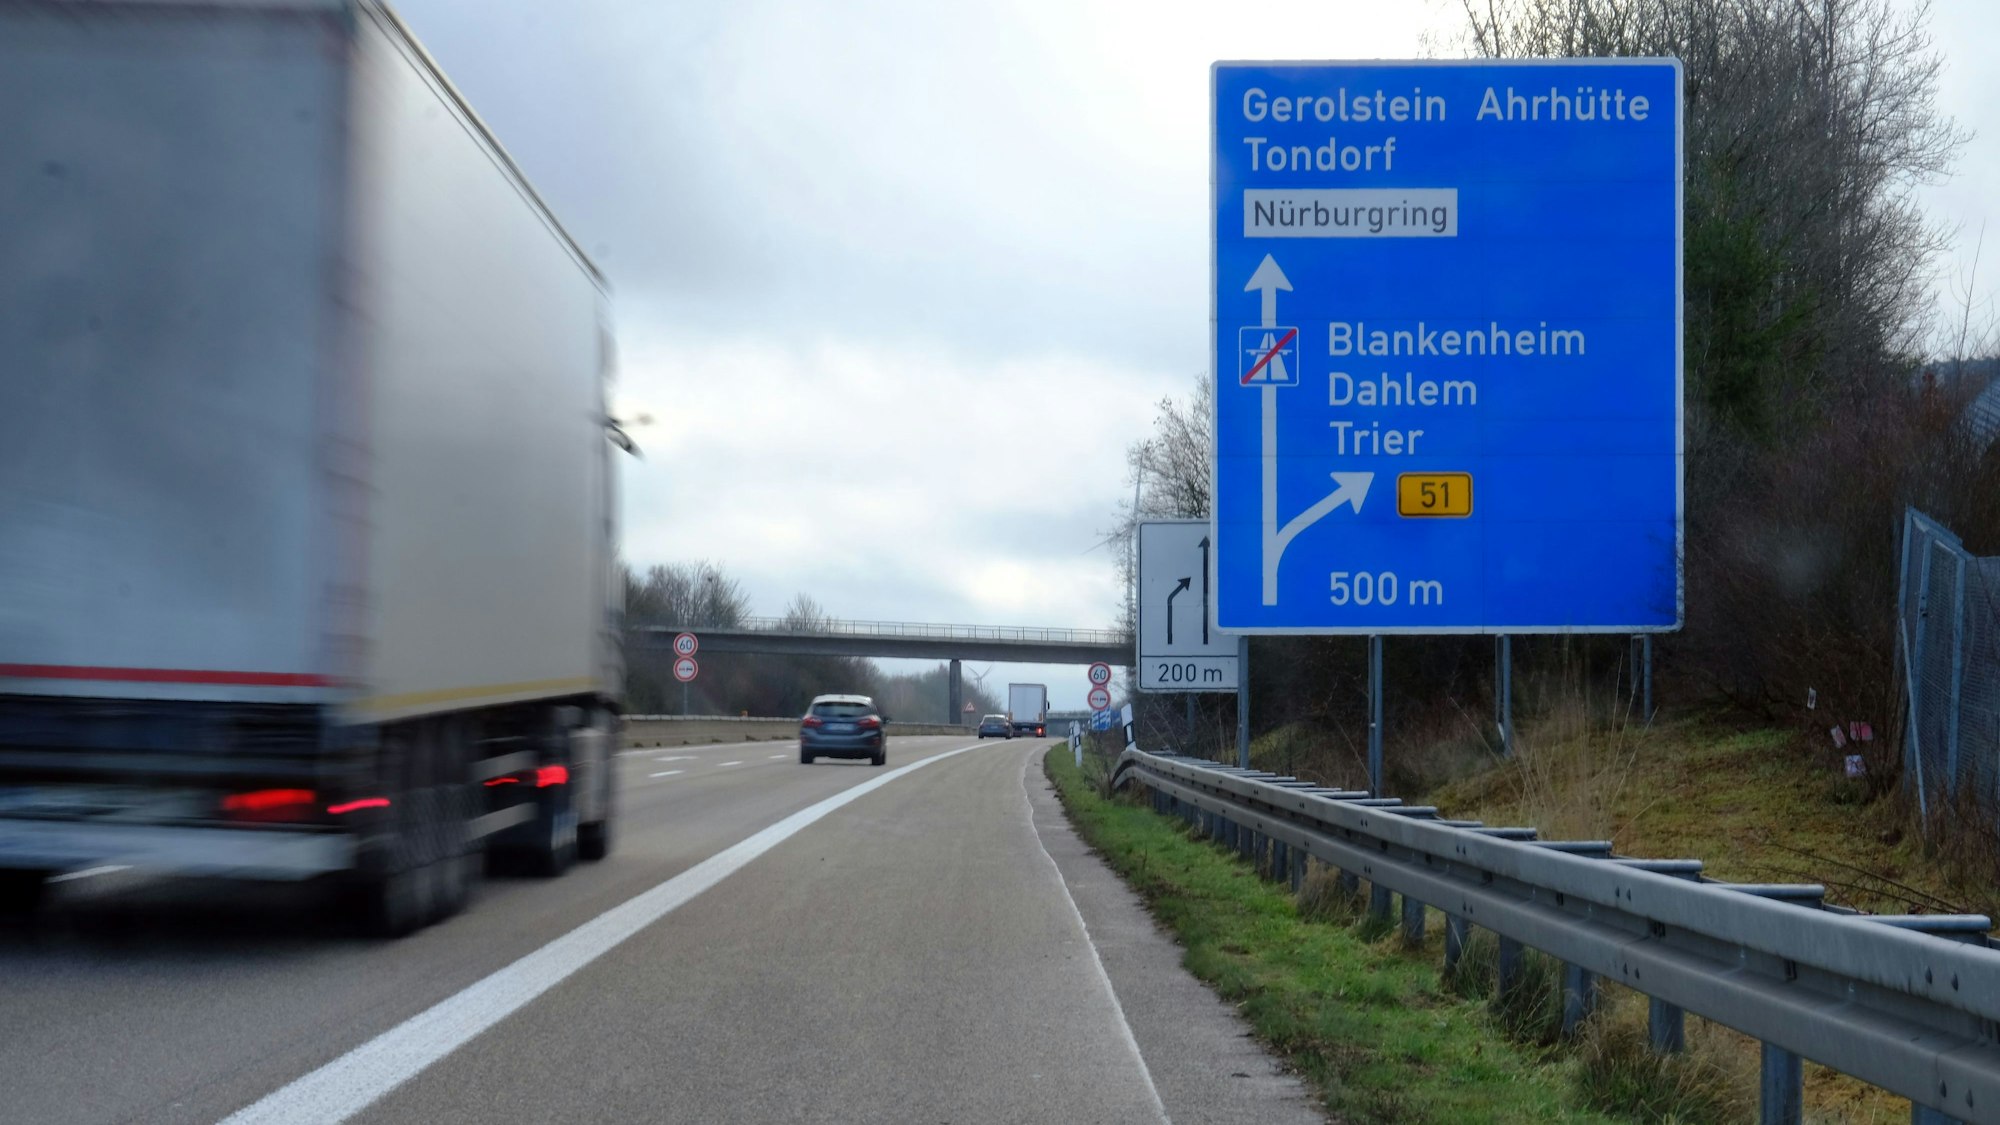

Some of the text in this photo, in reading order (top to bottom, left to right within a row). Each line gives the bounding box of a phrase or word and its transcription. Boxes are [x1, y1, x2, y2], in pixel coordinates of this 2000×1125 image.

[1242, 87, 1650, 122] Gerolstein Ahrhütte
[1243, 136, 1396, 171] Tondorf
[1253, 200, 1448, 233] Nürburgring
[1328, 321, 1586, 356] Blankenheim
[1328, 372, 1478, 406] Dahlem
[1329, 421, 1424, 455] Trier
[1420, 482, 1450, 508] 51
[1329, 572, 1443, 605] 500 m
[679, 639, 692, 650] 60
[1093, 669, 1107, 680] 60
[1158, 663, 1222, 682] 200 m
